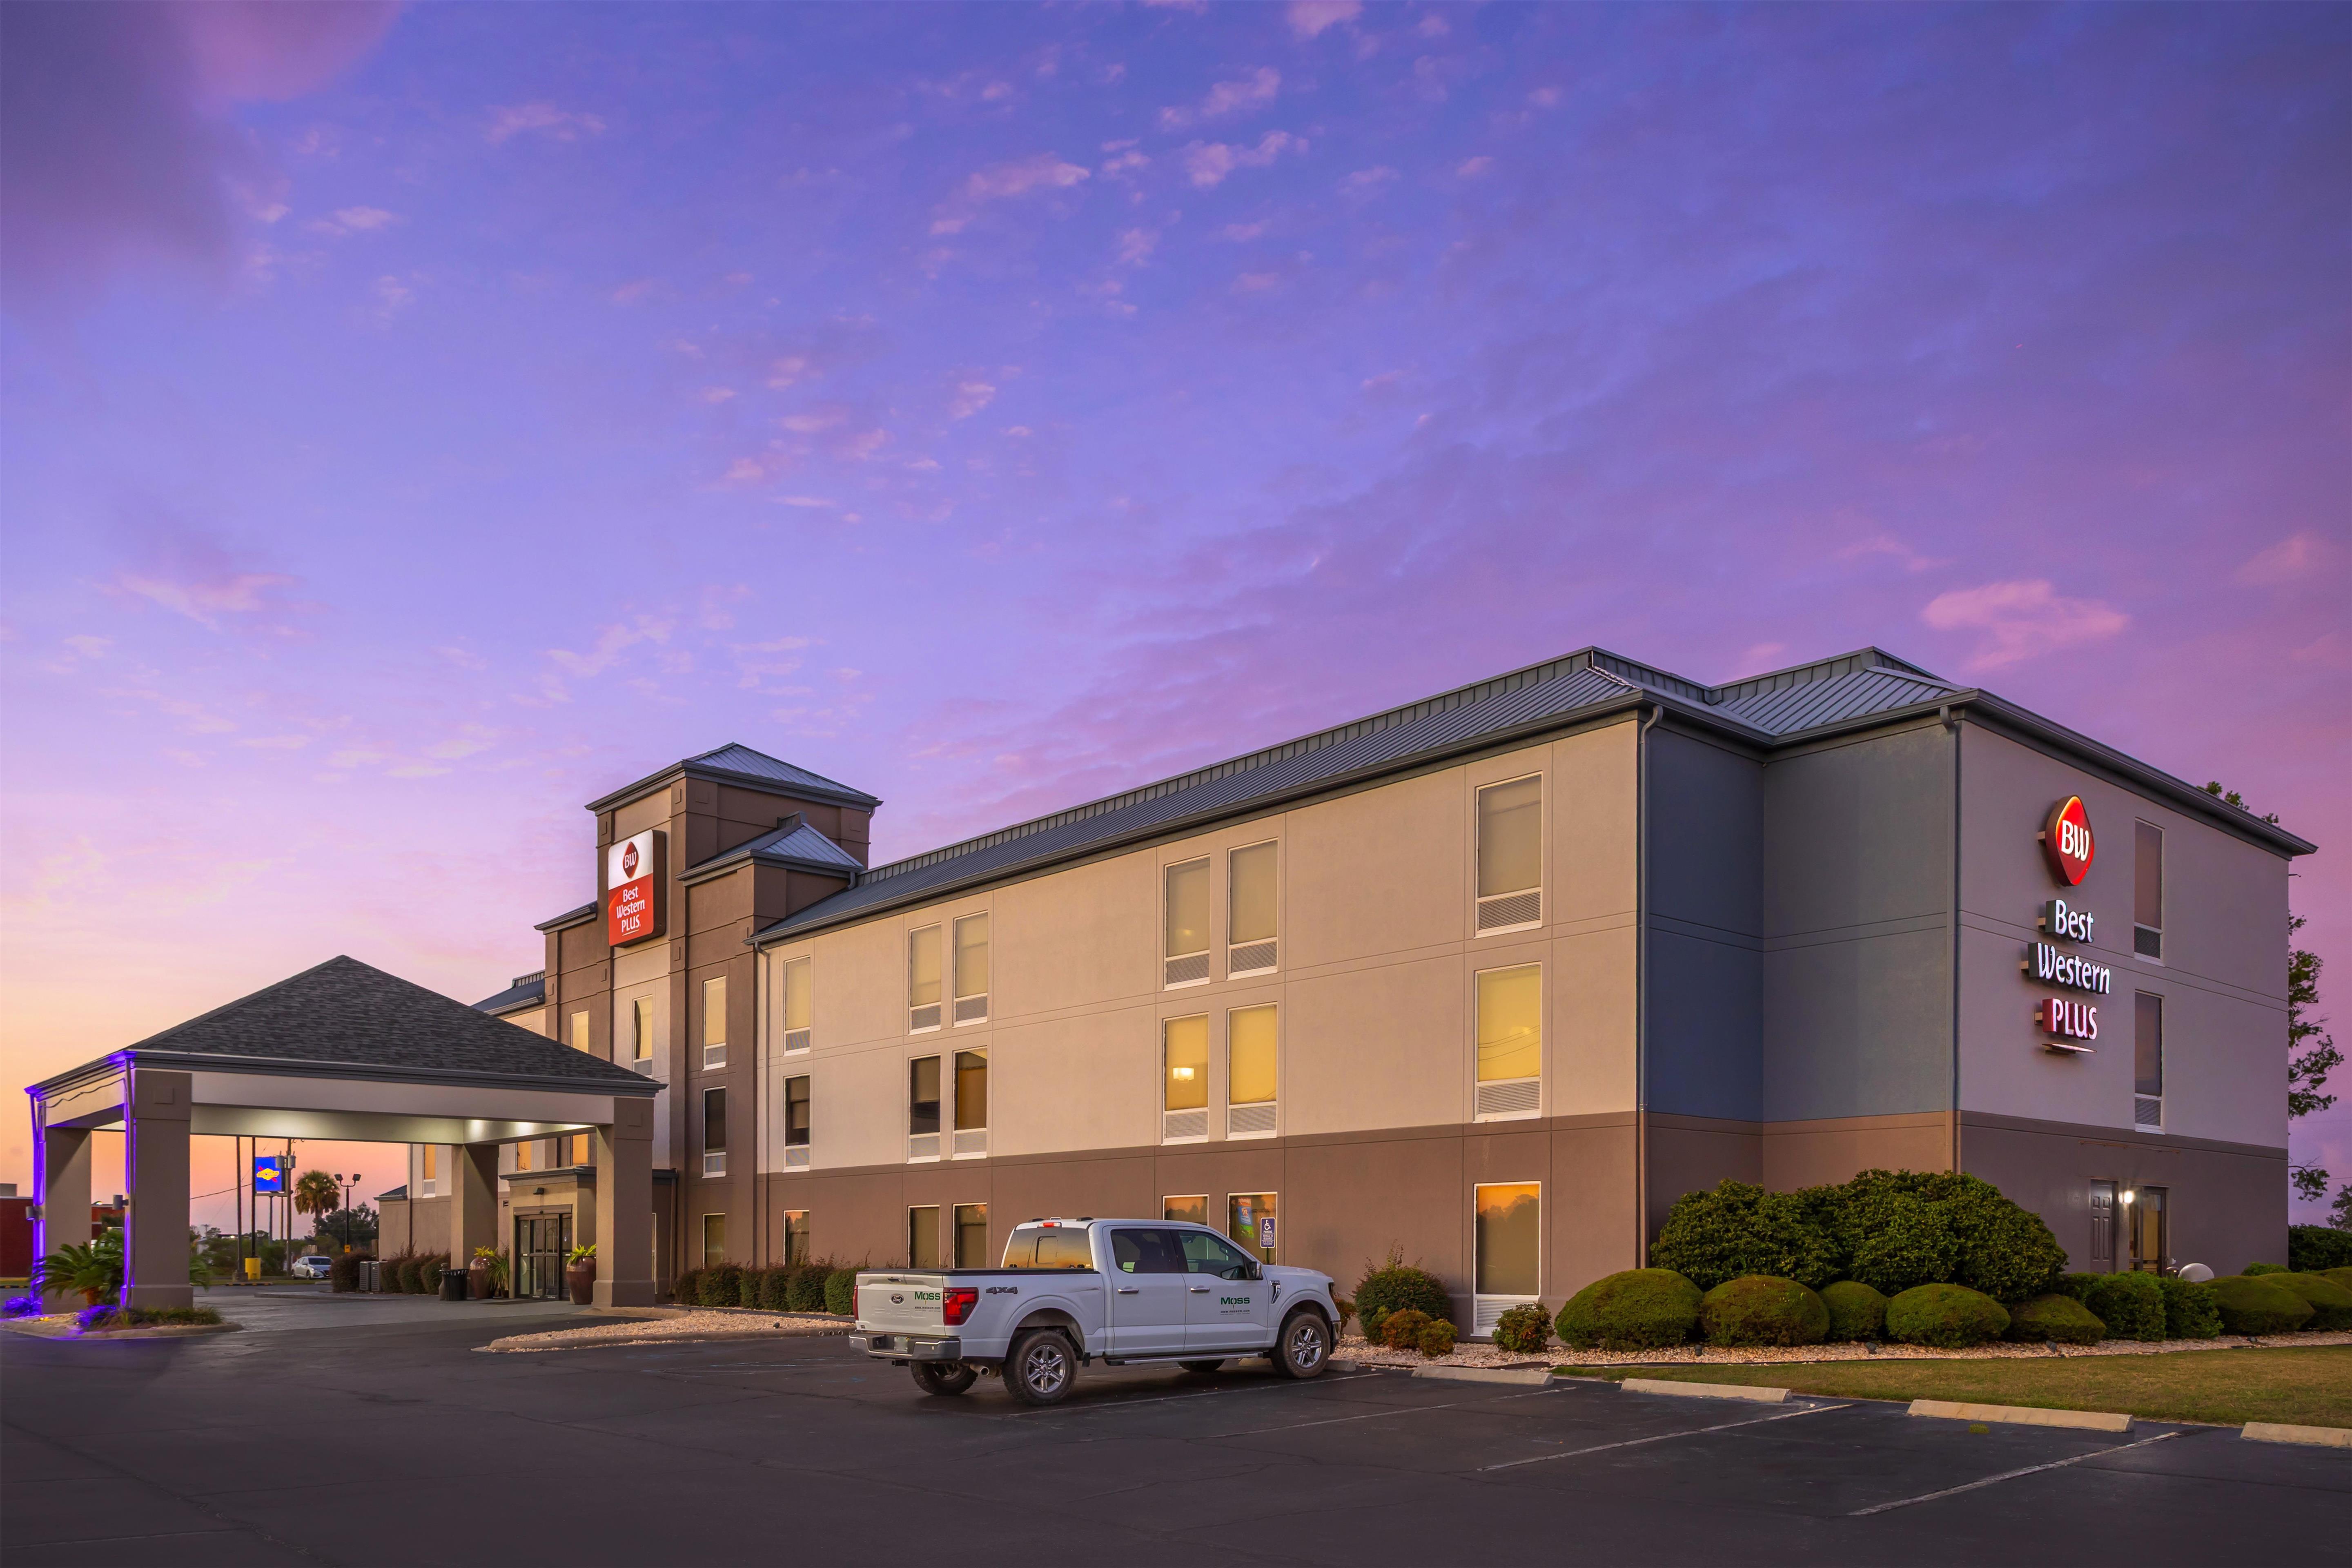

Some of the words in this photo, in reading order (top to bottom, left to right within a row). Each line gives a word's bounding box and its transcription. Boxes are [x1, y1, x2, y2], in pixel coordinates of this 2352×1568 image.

[2061, 820, 2089, 861] BW
[625, 851, 637, 869] BW
[617, 899, 645, 919] Western
[623, 886, 638, 902] Best
[621, 915, 640, 932] PLUS
[2055, 900, 2094, 943] Best
[2038, 942, 2110, 994] Western
[2052, 999, 2097, 1040] PLUS
